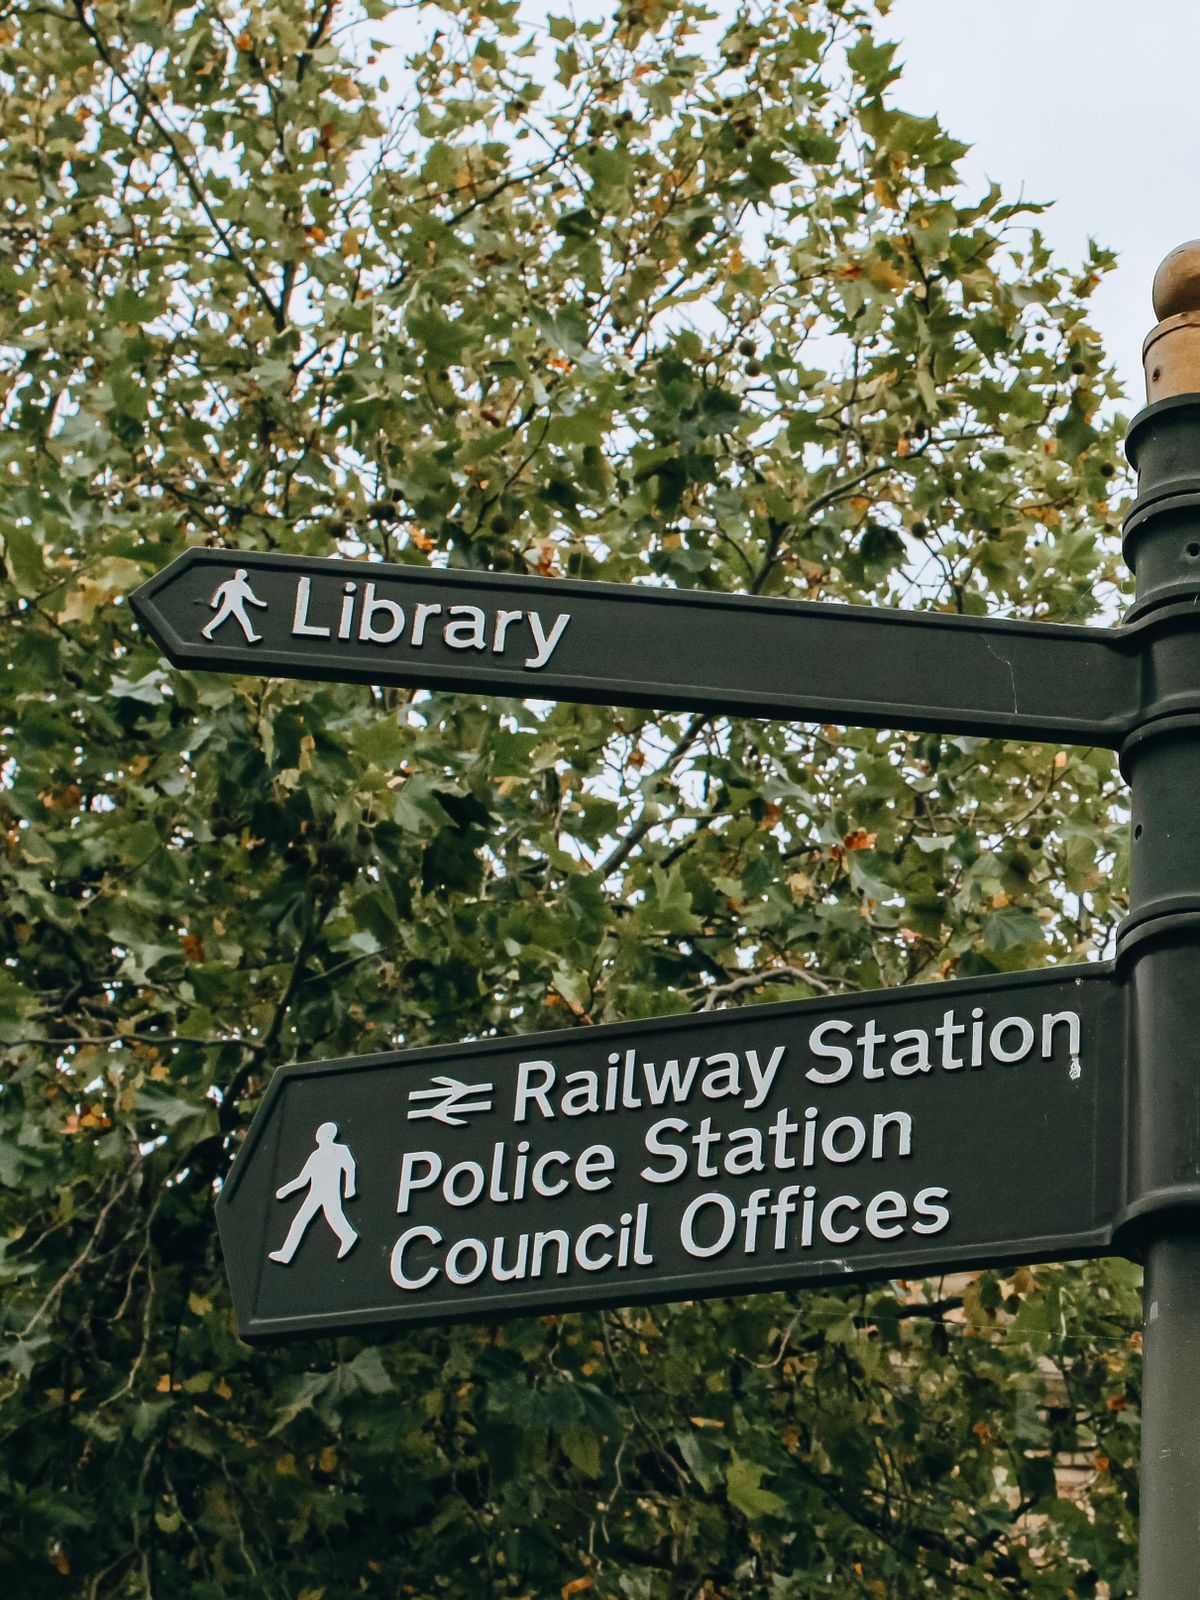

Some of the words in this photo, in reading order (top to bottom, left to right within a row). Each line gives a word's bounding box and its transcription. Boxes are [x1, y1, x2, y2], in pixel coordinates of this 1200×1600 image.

[291, 576, 571, 668] Library
[513, 1045, 787, 1123] Railway
[805, 1007, 1083, 1085] Station
[395, 1140, 616, 1214] Police
[640, 1106, 913, 1183] Station
[389, 1202, 654, 1291] Council
[680, 1185, 951, 1259] Offices
